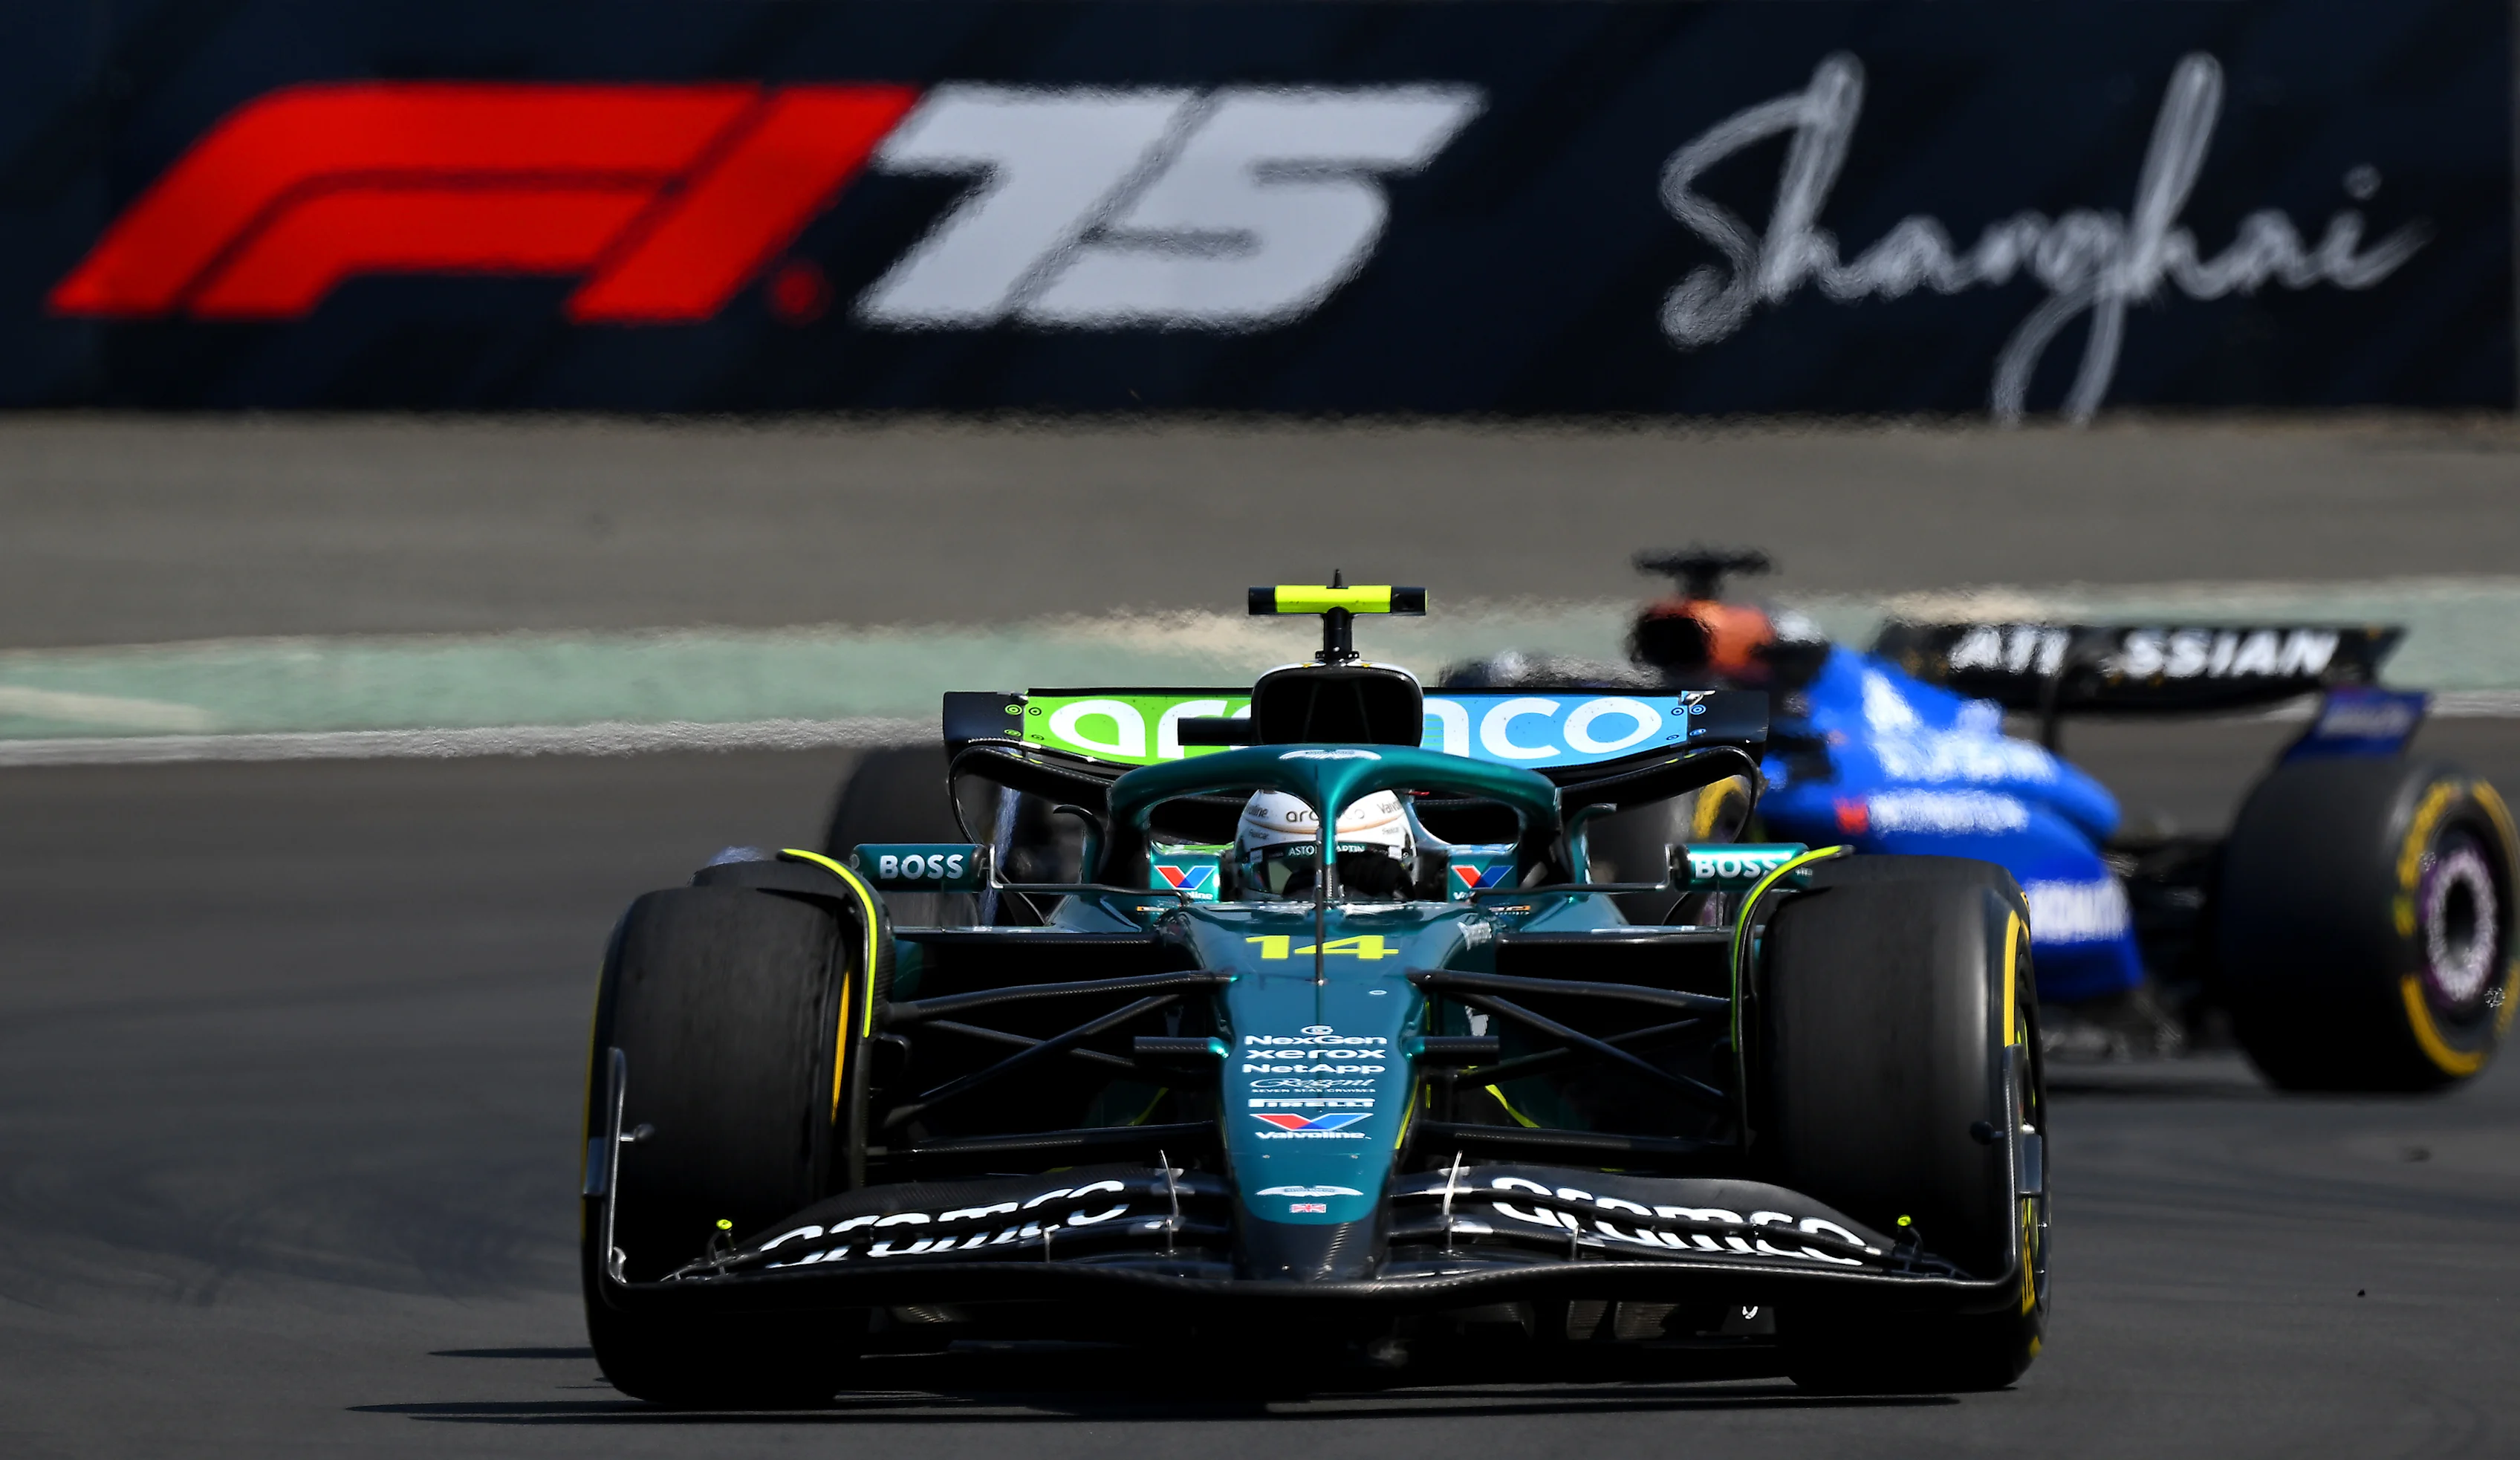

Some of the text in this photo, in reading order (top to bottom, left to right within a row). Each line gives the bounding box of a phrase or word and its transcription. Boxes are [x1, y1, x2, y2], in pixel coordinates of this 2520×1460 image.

[849, 82, 1487, 333] 75
[1658, 49, 2437, 428] Shanghai
[1048, 697, 1663, 759] arco
[1288, 845, 1365, 857] ASTO ARTIN
[879, 854, 964, 880] BOSS
[1246, 935, 1399, 959] 14
[1244, 1035, 1388, 1045] NexGen
[1245, 1049, 1386, 1059] xerox
[1241, 1063, 1386, 1074] NetApp
[1248, 1098, 1376, 1108] PIRELLI
[1254, 1131, 1366, 1140] Valvoline
